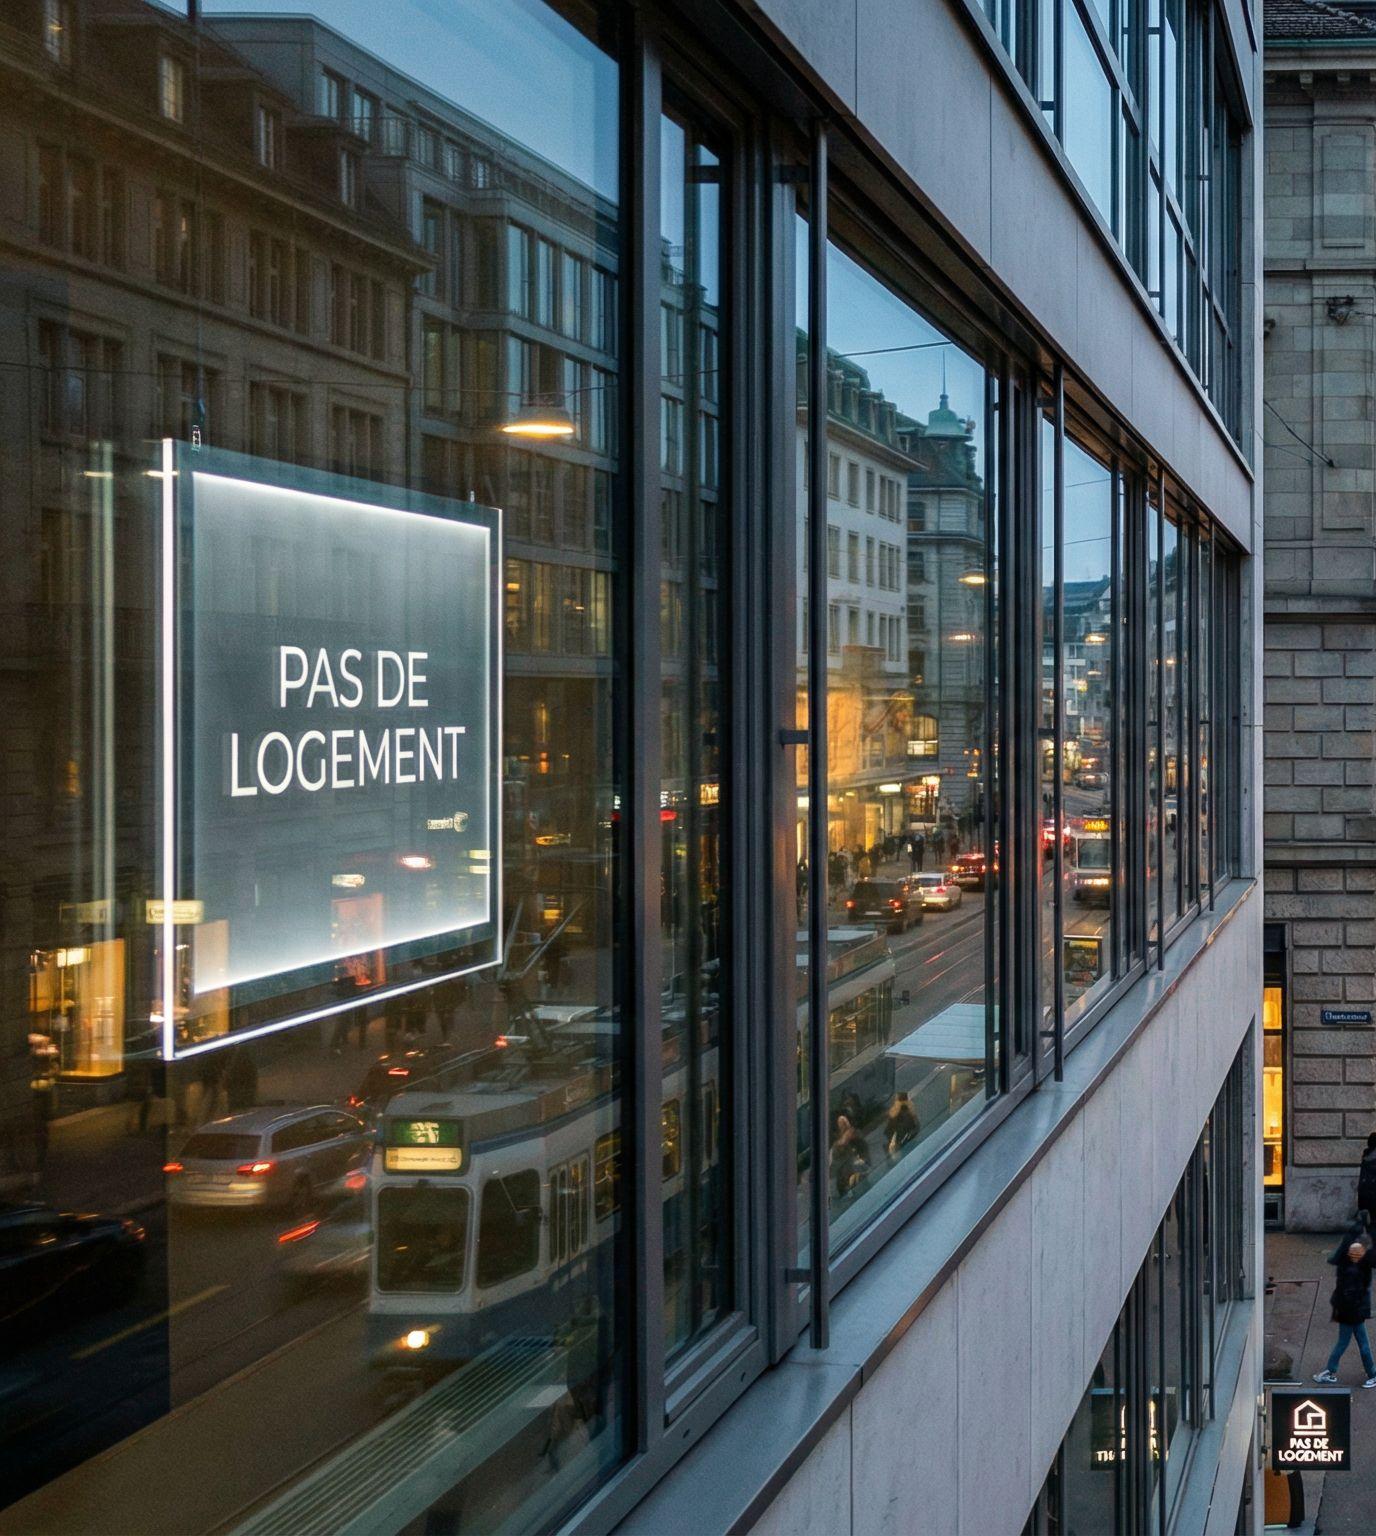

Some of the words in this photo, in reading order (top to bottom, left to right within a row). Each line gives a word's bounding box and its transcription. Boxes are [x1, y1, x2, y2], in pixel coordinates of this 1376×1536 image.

[280, 645, 363, 708] PAS
[378, 650, 429, 708] DE
[231, 726, 466, 797] LOGEMENT
[1289, 1437, 1312, 1449] PAS
[1313, 1438, 1329, 1449] DE
